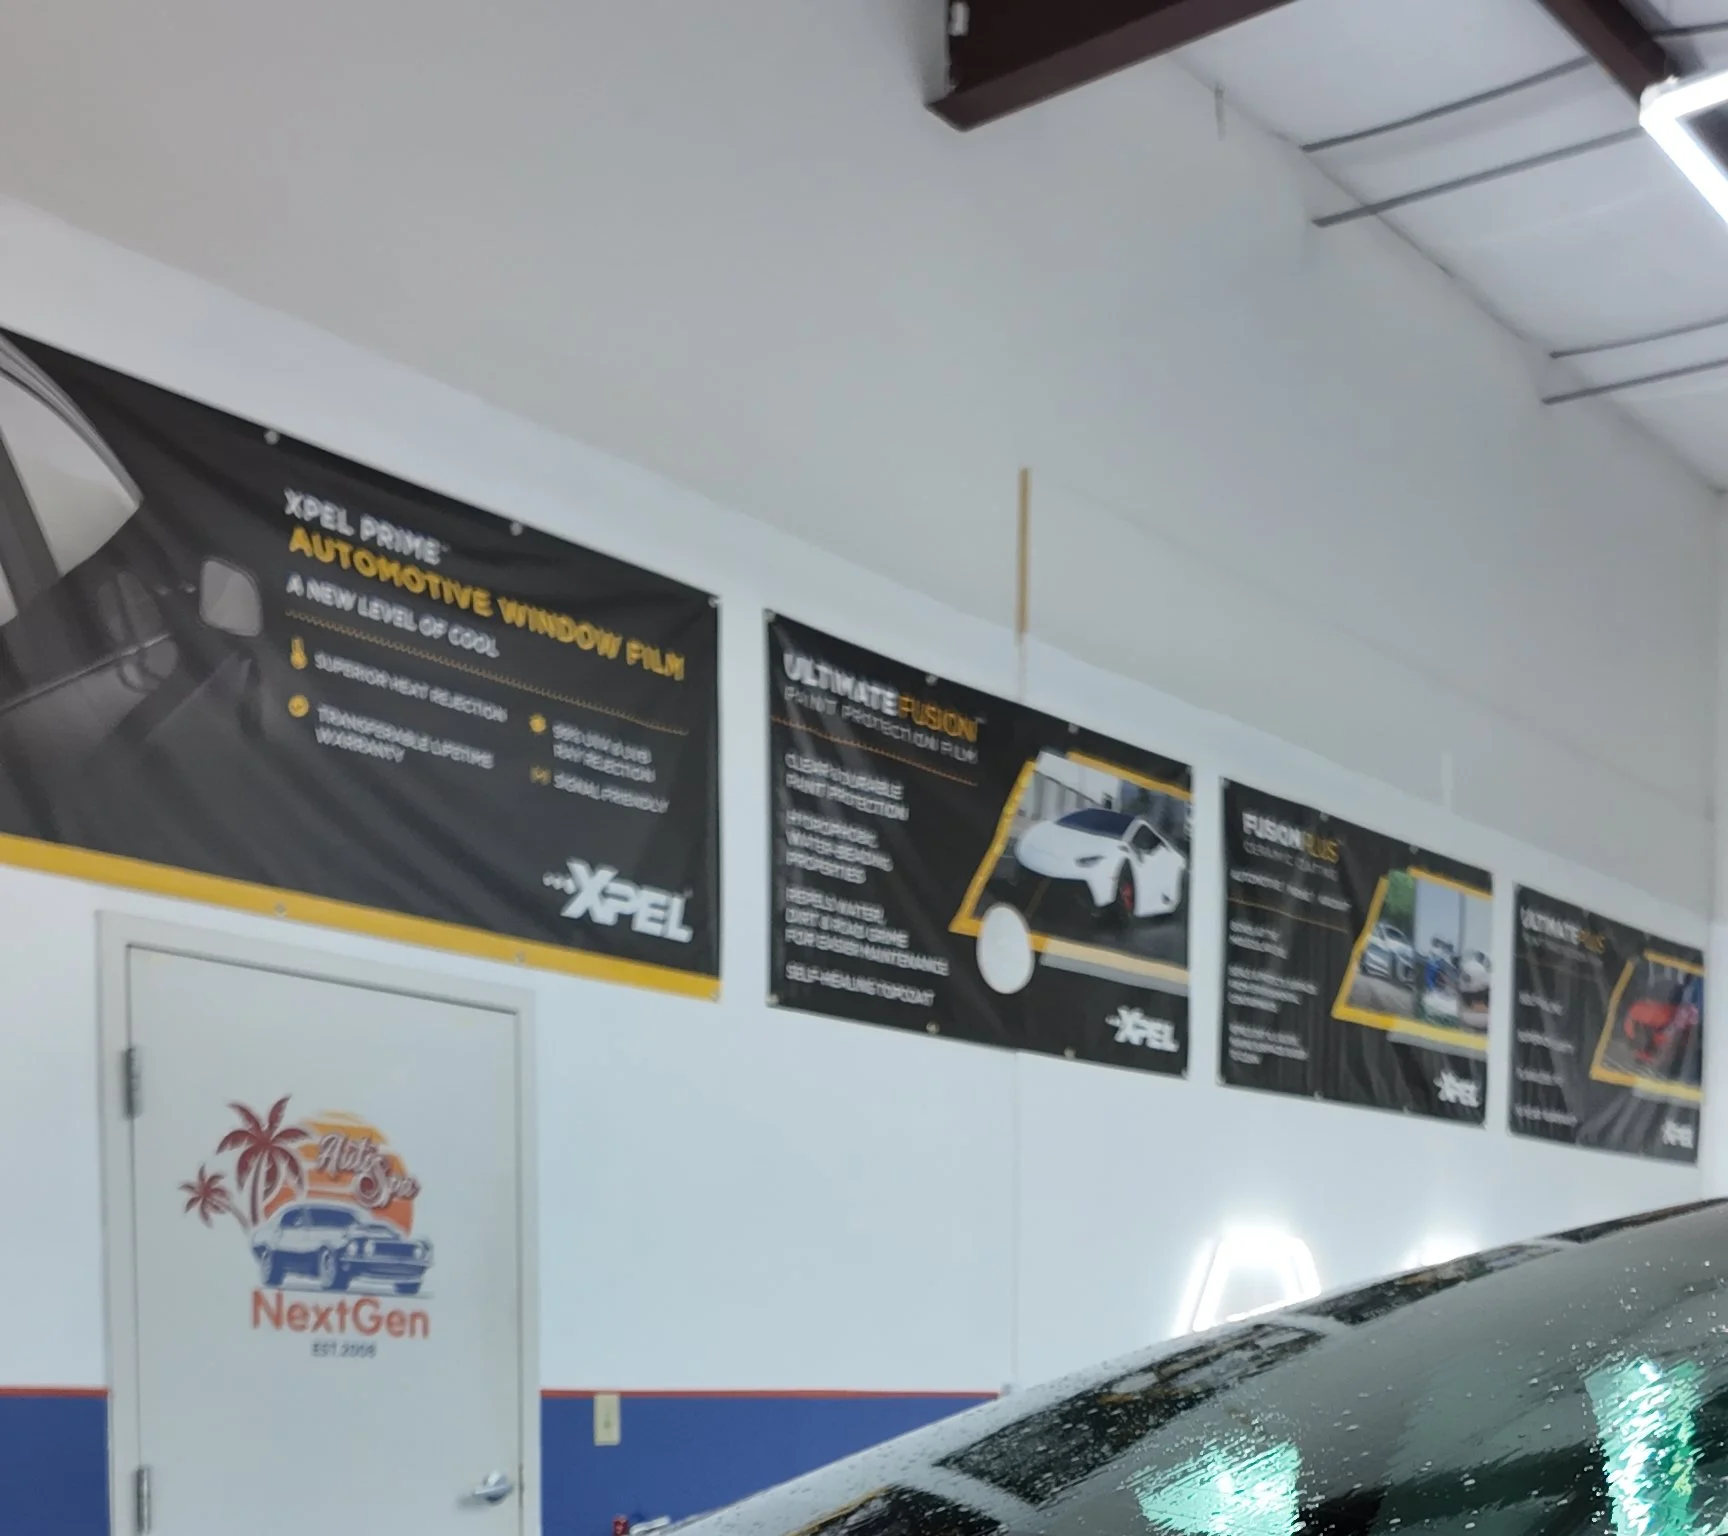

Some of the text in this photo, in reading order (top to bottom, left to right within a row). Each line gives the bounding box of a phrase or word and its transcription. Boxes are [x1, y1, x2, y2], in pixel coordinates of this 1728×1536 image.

[284, 488, 443, 565] XPEL PRIME
[287, 573, 499, 657] A NEW LEVEL OF COOL
[289, 527, 685, 681] AUTOMOTIVE WINDOW FILM
[314, 651, 508, 723] SUPERIOR HEAT REJECTION
[315, 726, 405, 763] WARRANTY
[317, 703, 495, 769] TRANSFERABLE LIFETIME
[785, 686, 978, 764] PAINT PROTECTION FILM
[583, 751, 656, 783] REJECTION
[826, 783, 910, 821] PROTECTION
[561, 857, 693, 943] XPEL
[785, 850, 866, 884] PROPERTIES
[1114, 1005, 1180, 1053] XPEL
[252, 1288, 429, 1338] NextGen
